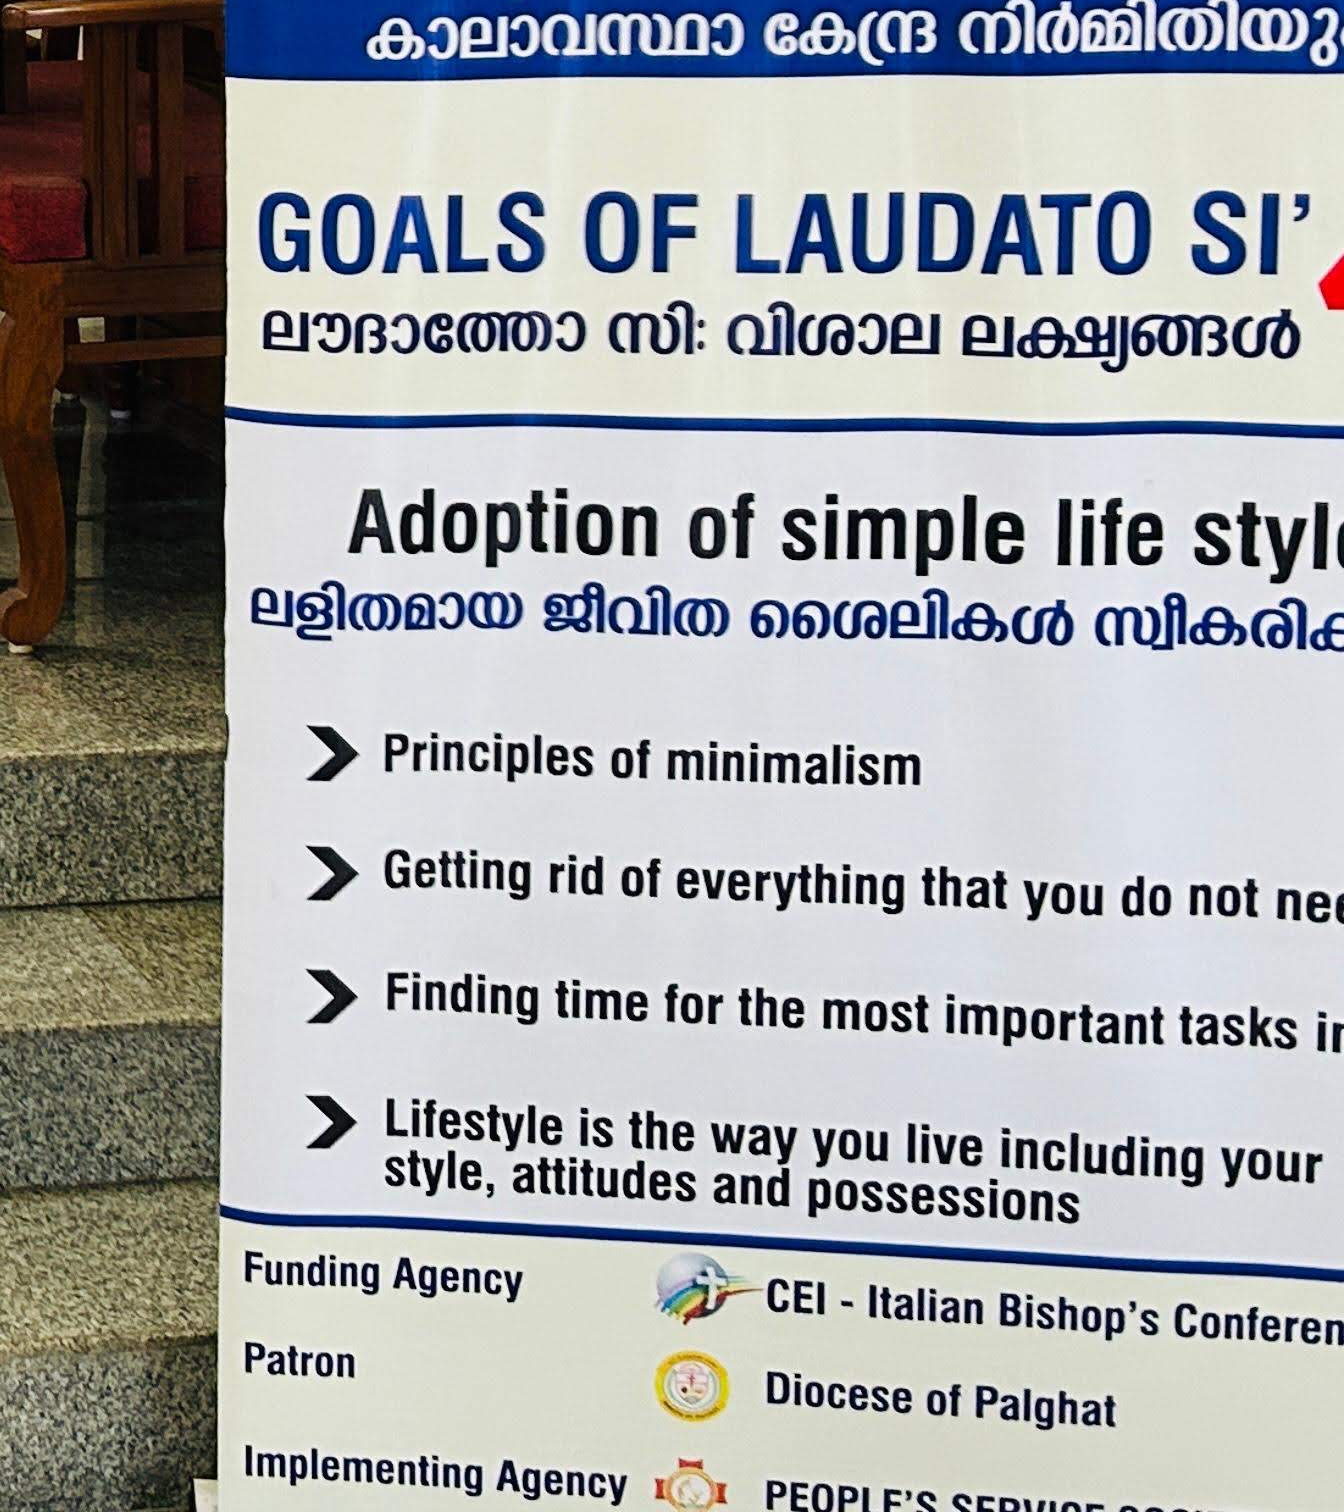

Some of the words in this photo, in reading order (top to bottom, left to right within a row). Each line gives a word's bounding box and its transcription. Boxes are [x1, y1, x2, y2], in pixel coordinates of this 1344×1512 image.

[366, 12, 745, 61] കാലാവസ്ഥാ
[763, 10, 937, 67] കേന്ദ്ര
[258, 191, 546, 276] GOALS
[584, 190, 699, 274] OF
[735, 190, 1152, 276] LAUDATO
[727, 300, 941, 357] വിശാല
[961, 308, 1301, 374] ലക്ഷ്യങ്ങൾ
[347, 487, 658, 568] Adoption
[688, 492, 755, 560] of
[780, 493, 1025, 577] simple
[1057, 497, 1164, 567] life
[250, 579, 524, 642] ലളിതമായ
[543, 581, 730, 638] ജീവിത
[750, 587, 1075, 647] ശൈലികൾ
[384, 732, 594, 783] Principles
[610, 739, 651, 779] of
[667, 740, 921, 786] minimalism
[384, 849, 531, 901] Getting
[549, 854, 604, 896] rid
[621, 857, 661, 898] of
[676, 863, 905, 915] everything
[921, 865, 1008, 910] that
[1023, 880, 1104, 922] you
[1121, 875, 1172, 918] do
[1189, 878, 1259, 918] not
[386, 971, 539, 1026] Finding
[554, 979, 649, 1022] time
[664, 983, 724, 1025] for
[738, 986, 805, 1029] the
[822, 994, 929, 1034] most
[945, 993, 1165, 1047] important
[1179, 1005, 1298, 1050] tasks
[386, 1098, 563, 1152] Lifestyle
[579, 1107, 614, 1149] is
[628, 1110, 695, 1152] the
[710, 1122, 798, 1166] way
[812, 1128, 889, 1168] you
[907, 1122, 983, 1167] live
[1001, 1127, 1204, 1188] including
[1220, 1147, 1323, 1189] your
[384, 1149, 495, 1199] style,
[512, 1156, 697, 1203] attitudes
[713, 1167, 790, 1208] and
[807, 1178, 1080, 1225] possessions
[244, 1250, 380, 1296] Funding
[392, 1256, 524, 1304] Agency
[767, 1278, 825, 1316] CEI
[868, 1284, 984, 1325] Italian
[1174, 1302, 1344, 1346] Conferen
[244, 1341, 355, 1379] Patron
[766, 1371, 913, 1414] Diocese
[926, 1383, 962, 1417] of
[975, 1385, 1116, 1431] Palghat
[245, 1444, 483, 1498] Implementing
[496, 1459, 628, 1507] Agency
